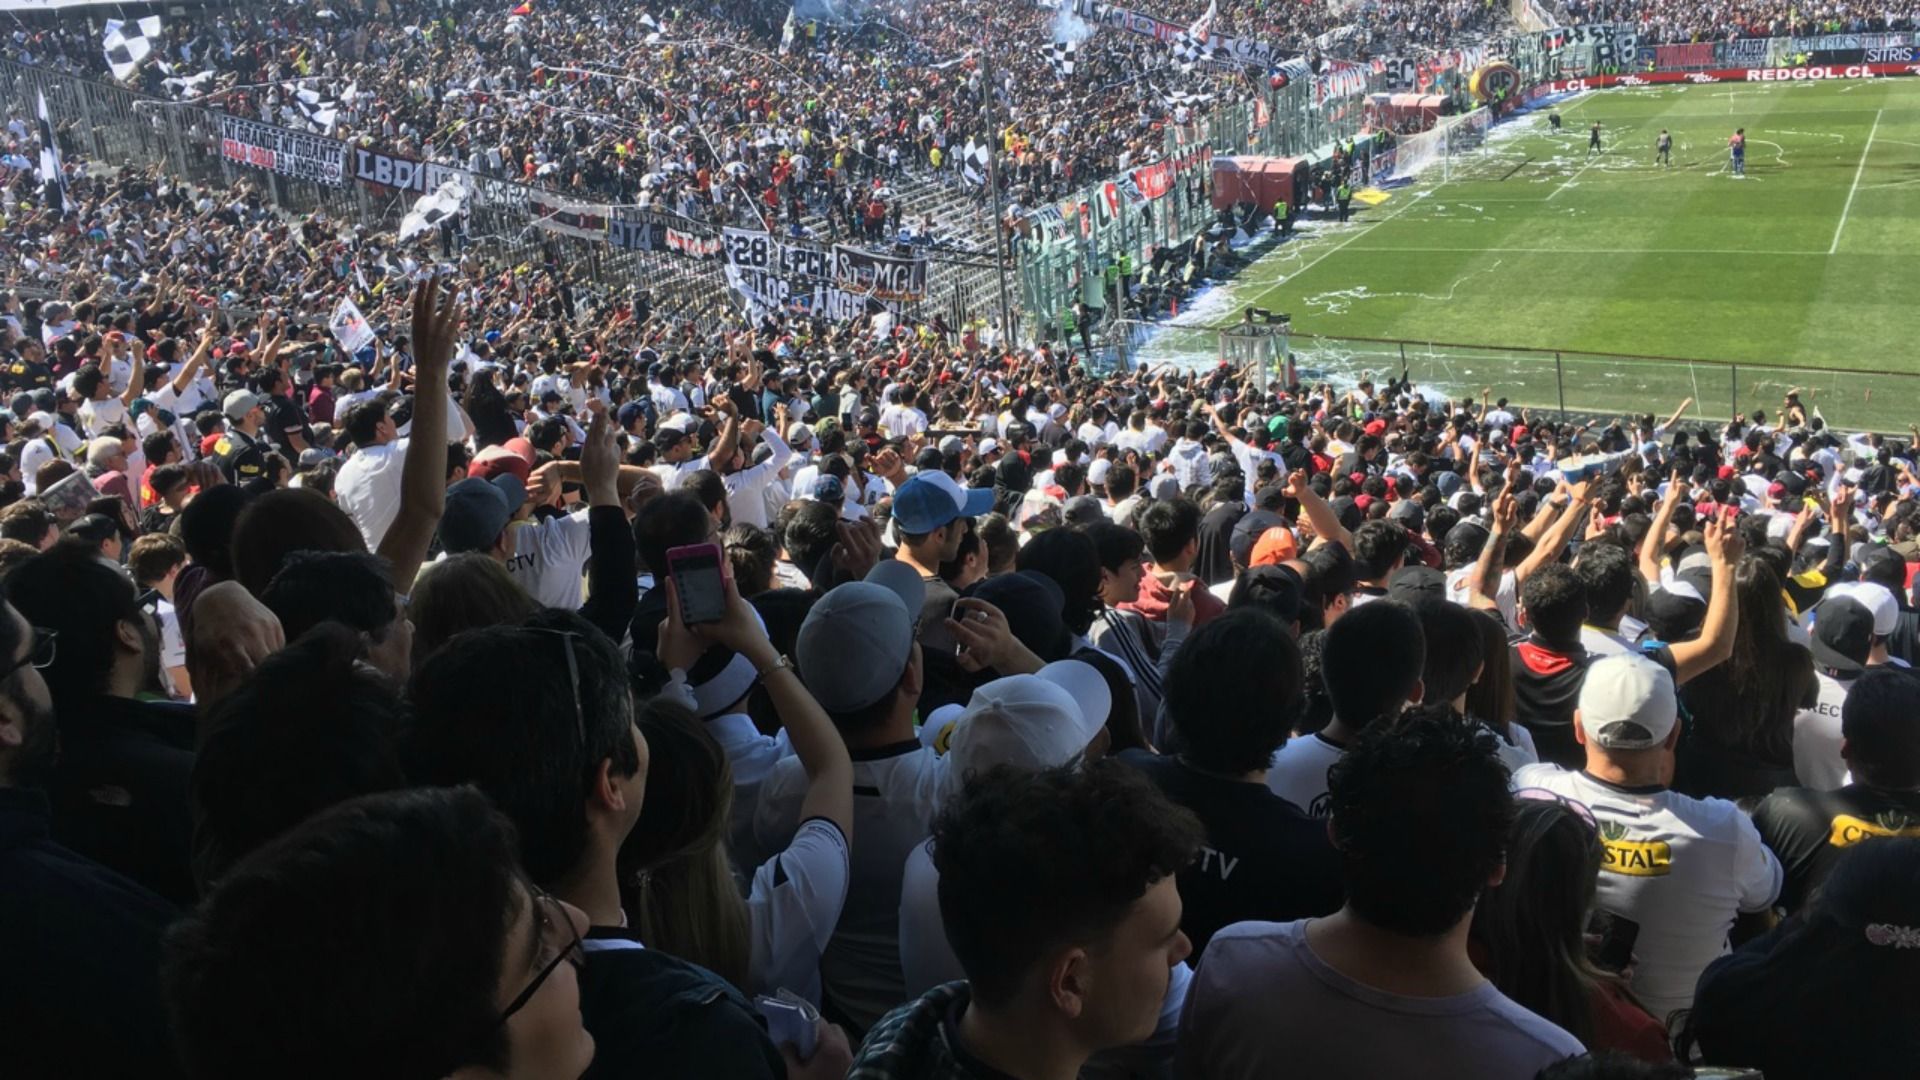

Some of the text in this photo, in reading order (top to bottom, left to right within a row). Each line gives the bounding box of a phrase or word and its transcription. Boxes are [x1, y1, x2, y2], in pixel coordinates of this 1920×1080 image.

[1747, 65, 1875, 81] REDGOL.CL
[224, 121, 340, 164] NI GRANDE NI GIGANTE
[356, 149, 424, 191] LBDI
[506, 552, 535, 573] CTV
[1201, 846, 1239, 880] TV
[1603, 845, 1663, 869] STAL
